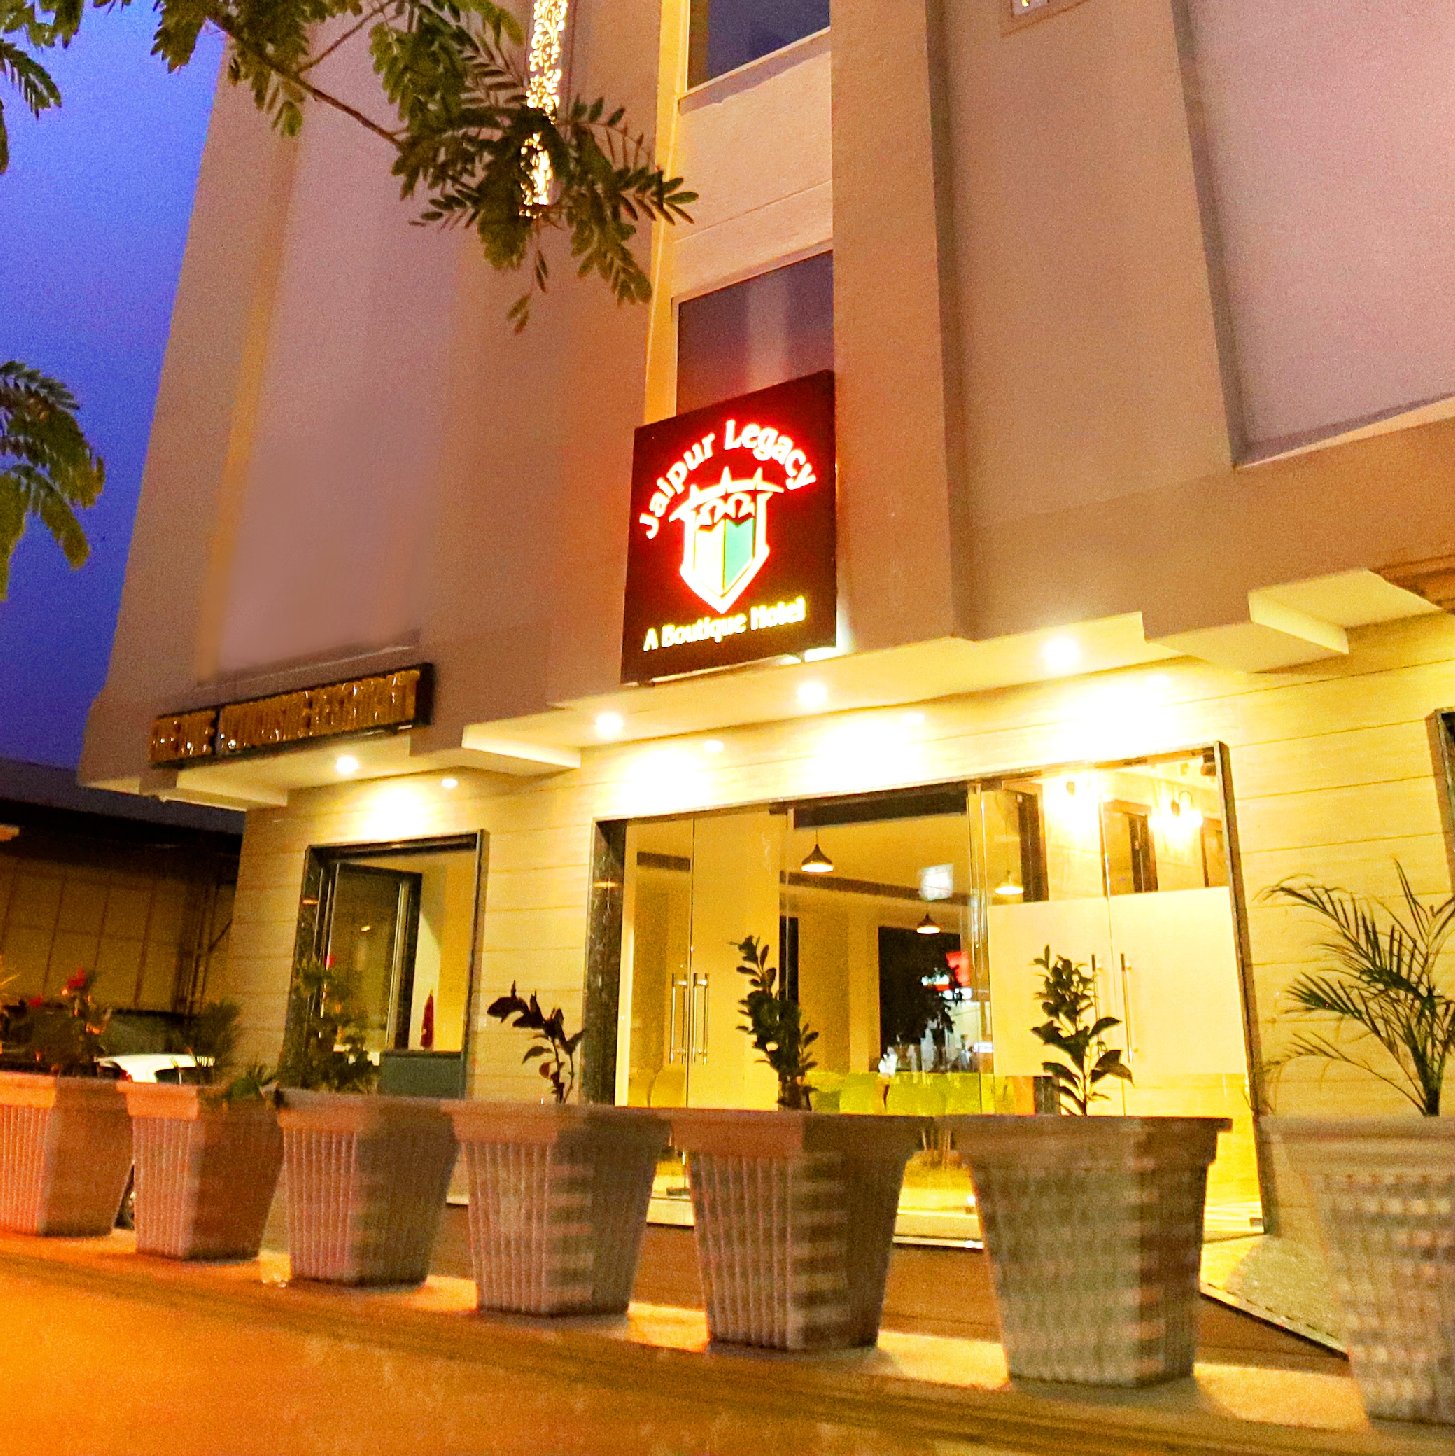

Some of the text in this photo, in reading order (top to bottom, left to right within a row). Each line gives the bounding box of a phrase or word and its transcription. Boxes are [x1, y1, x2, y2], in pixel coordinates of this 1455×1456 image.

[639, 419, 816, 539] Jaipur Legacy
[643, 595, 807, 651] A Boutique Hotel
